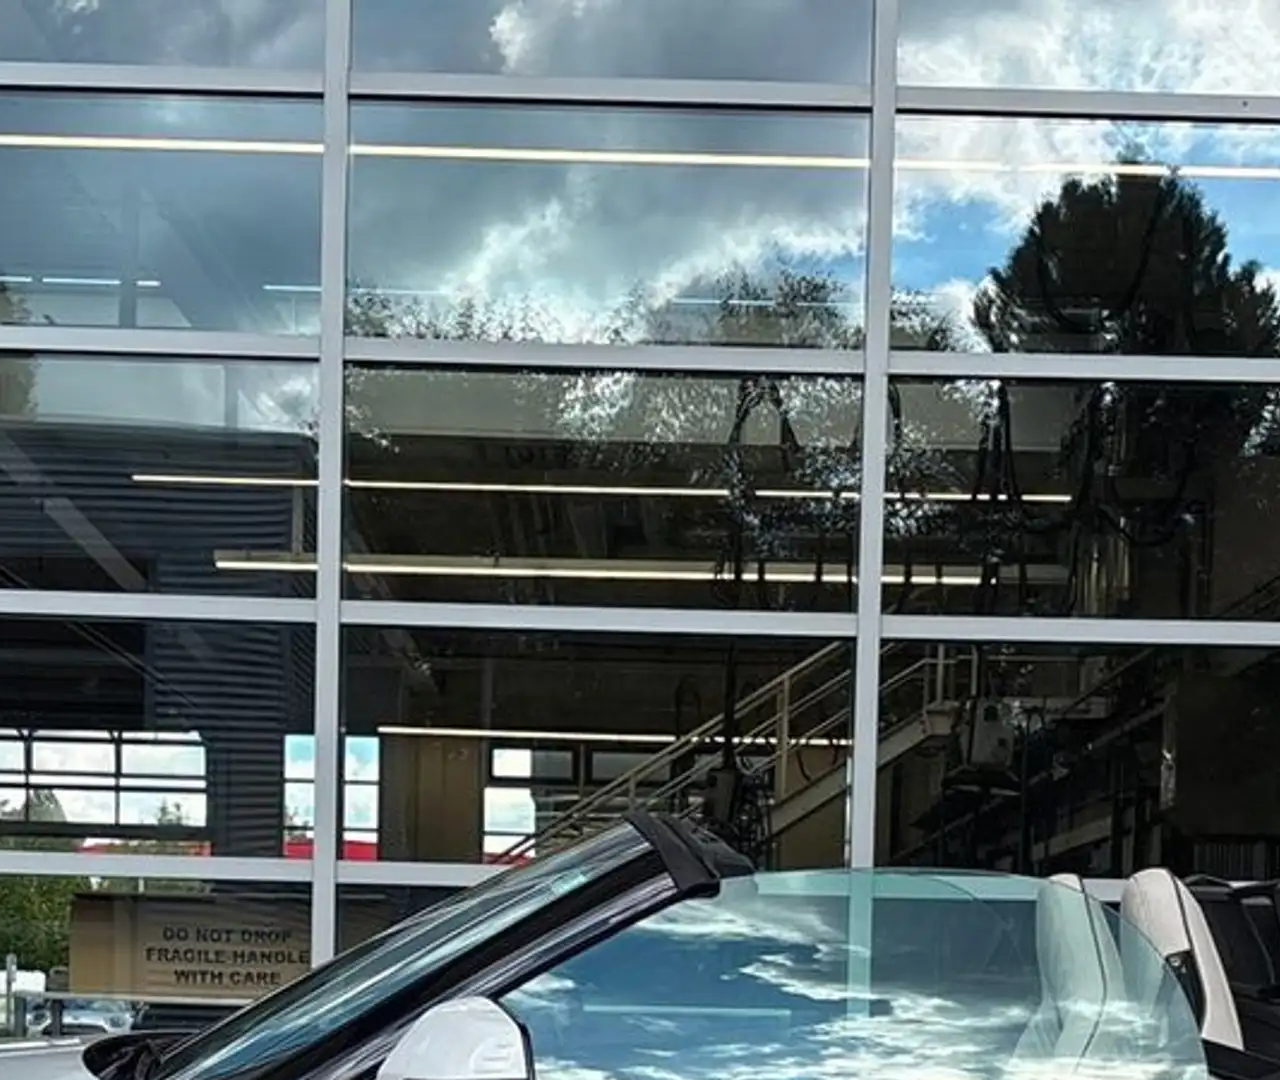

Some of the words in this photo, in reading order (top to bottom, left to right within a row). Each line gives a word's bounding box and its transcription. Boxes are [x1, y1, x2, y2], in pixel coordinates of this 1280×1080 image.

[162, 926, 190, 942] DO
[196, 927, 234, 944] NOT
[241, 928, 293, 944] DROP
[232, 949, 310, 965] HANDLE
[173, 968, 224, 985] WITH
[229, 970, 282, 986] CARE
